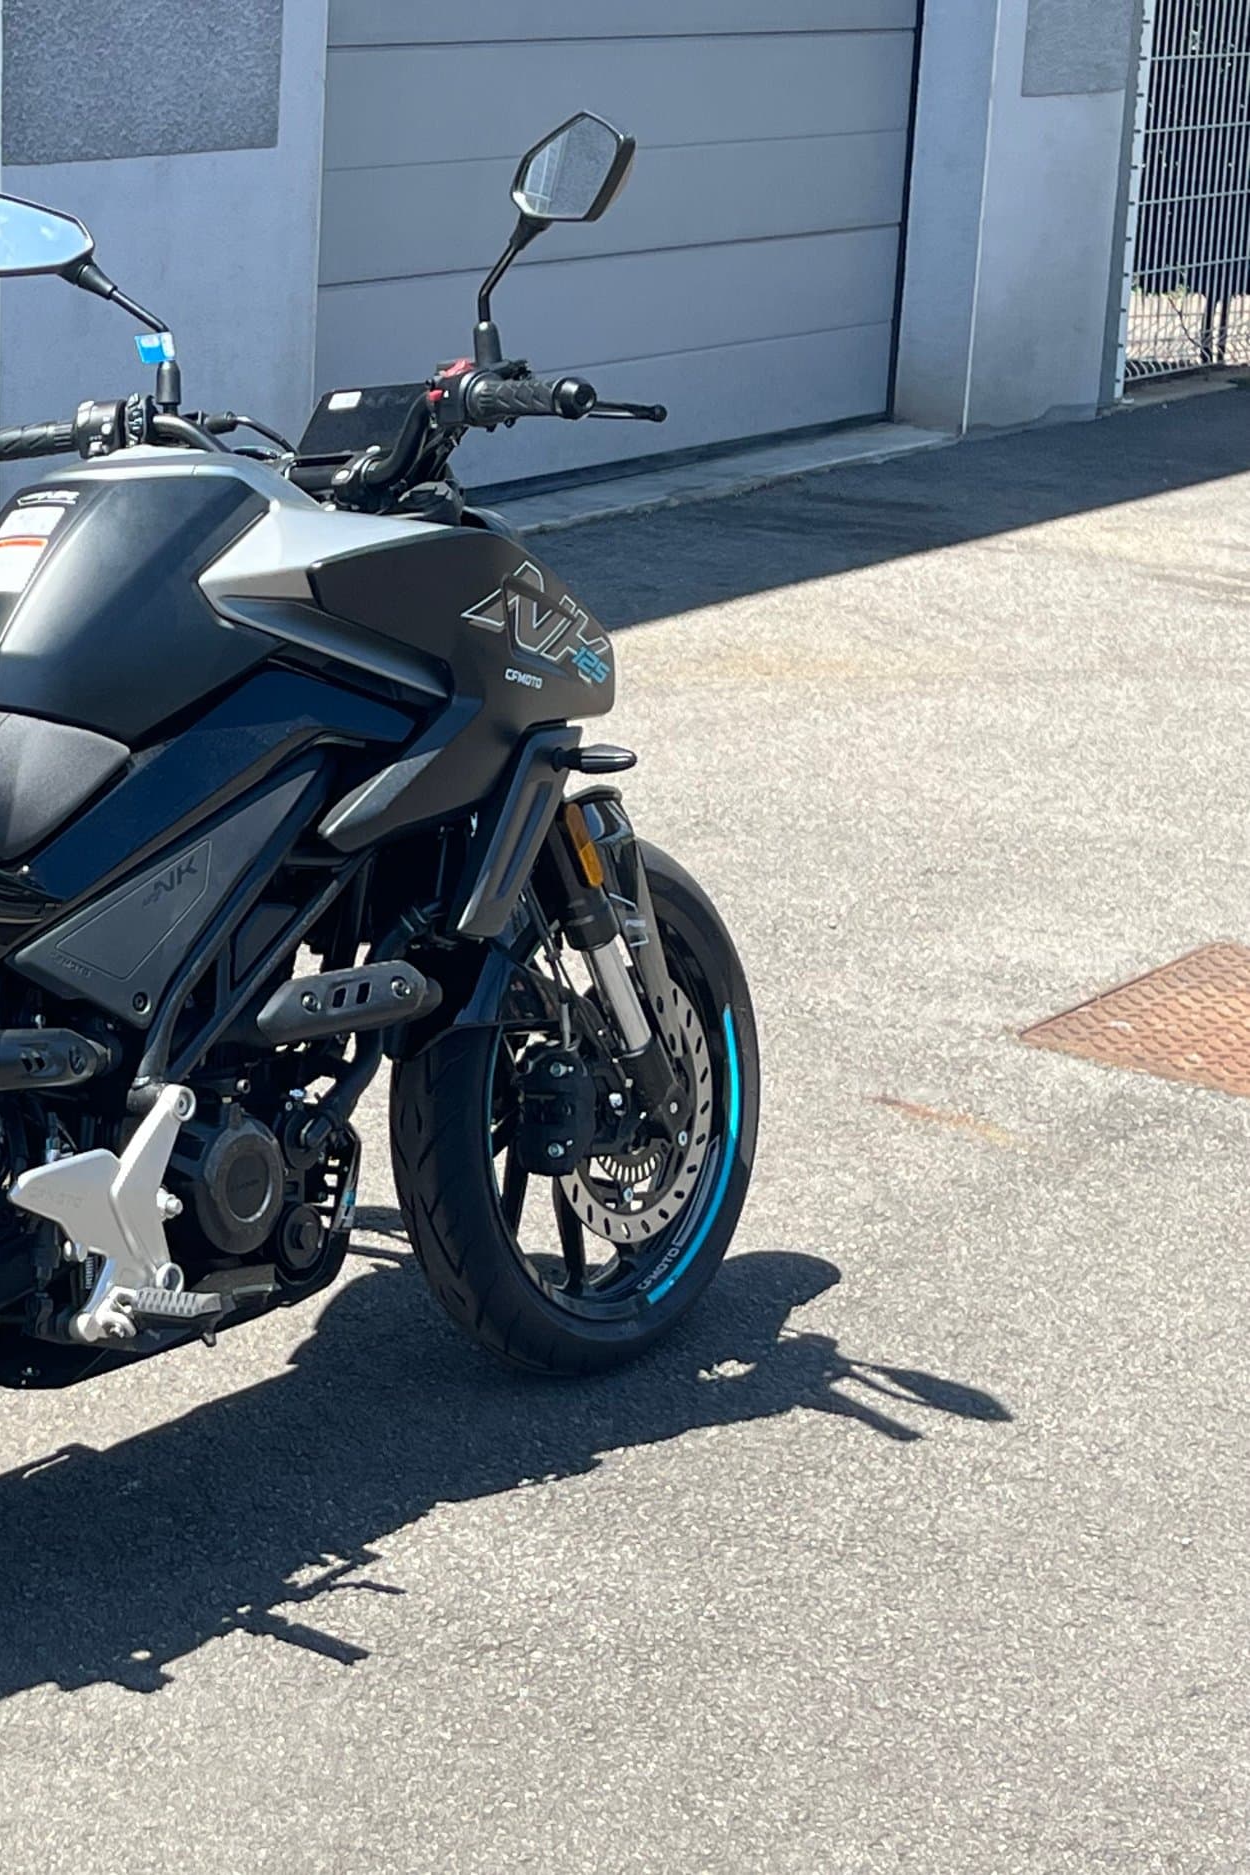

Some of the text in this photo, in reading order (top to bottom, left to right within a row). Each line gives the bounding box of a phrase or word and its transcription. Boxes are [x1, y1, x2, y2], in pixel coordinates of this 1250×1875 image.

[504, 668, 543, 689] CFMOTO
[570, 646, 611, 684] 125
[153, 855, 198, 892] NK
[636, 1247, 680, 1290] CFMOTO
